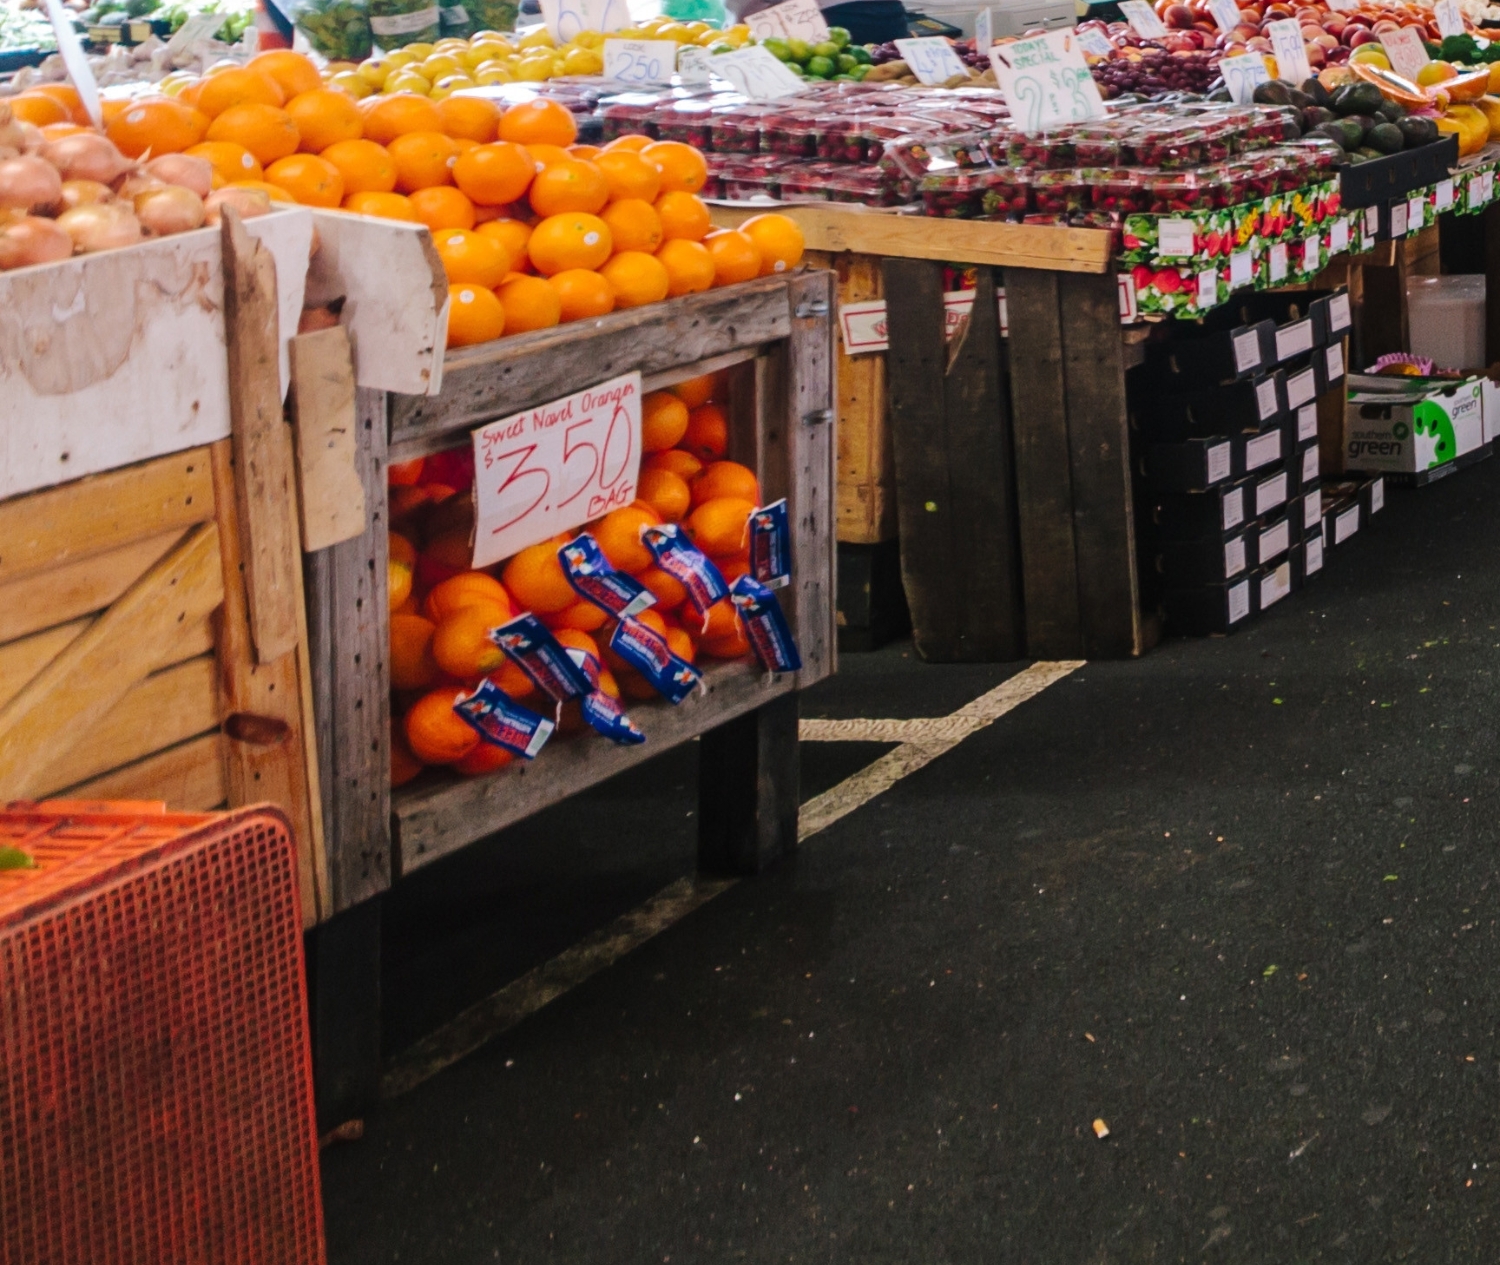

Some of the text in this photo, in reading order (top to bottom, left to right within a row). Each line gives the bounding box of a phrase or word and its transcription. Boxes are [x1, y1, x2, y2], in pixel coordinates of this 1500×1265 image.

[480, 417, 525, 450] Sweet
[580, 382, 635, 414] Oranges
[1451, 398, 1478, 420] green
[1349, 440, 1402, 459] green
[586, 480, 634, 519] BAG
